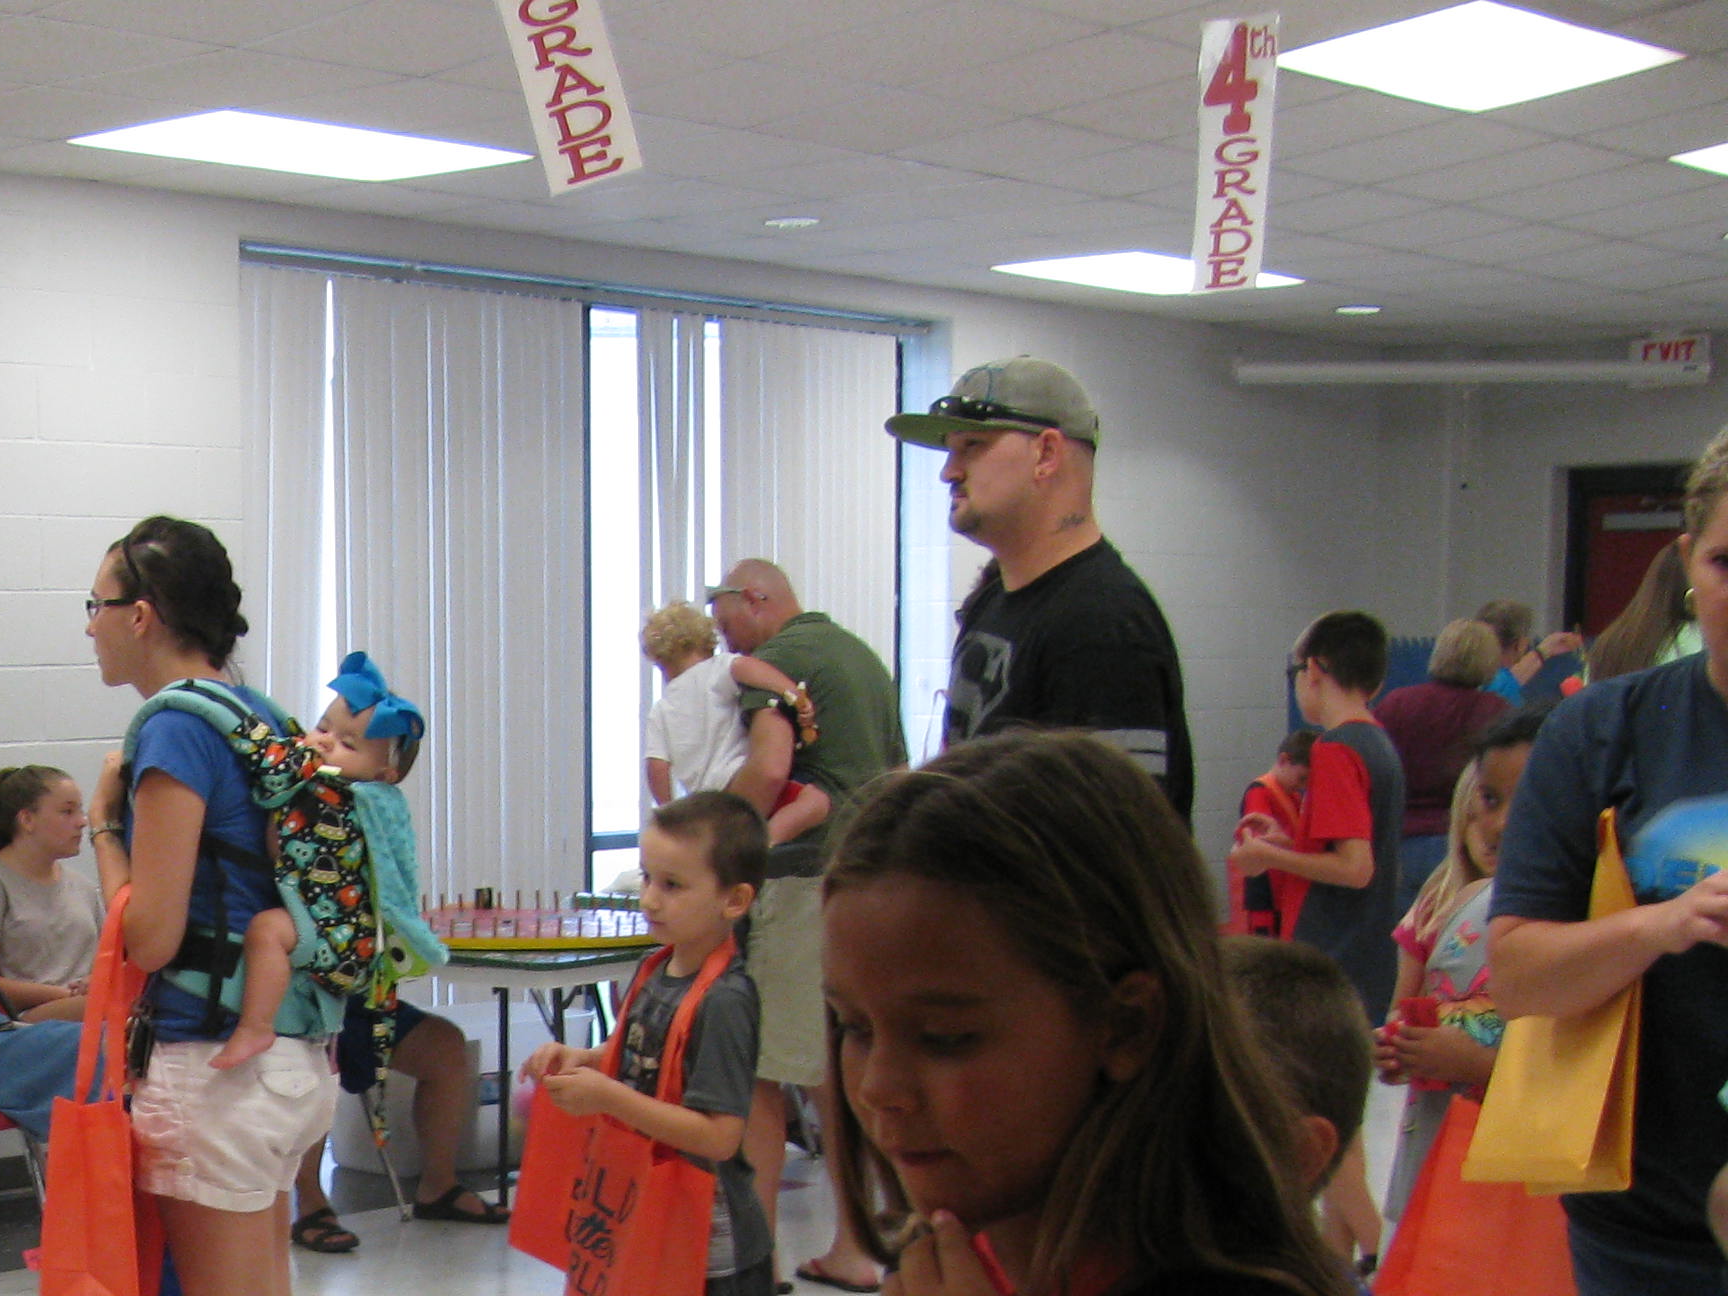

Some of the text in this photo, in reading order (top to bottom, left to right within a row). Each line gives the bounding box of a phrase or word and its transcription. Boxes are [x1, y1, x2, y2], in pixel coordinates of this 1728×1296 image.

[518, 0, 624, 185] GRADE
[1203, 22, 1277, 135] 4th
[1205, 137, 1260, 290] GRADE
